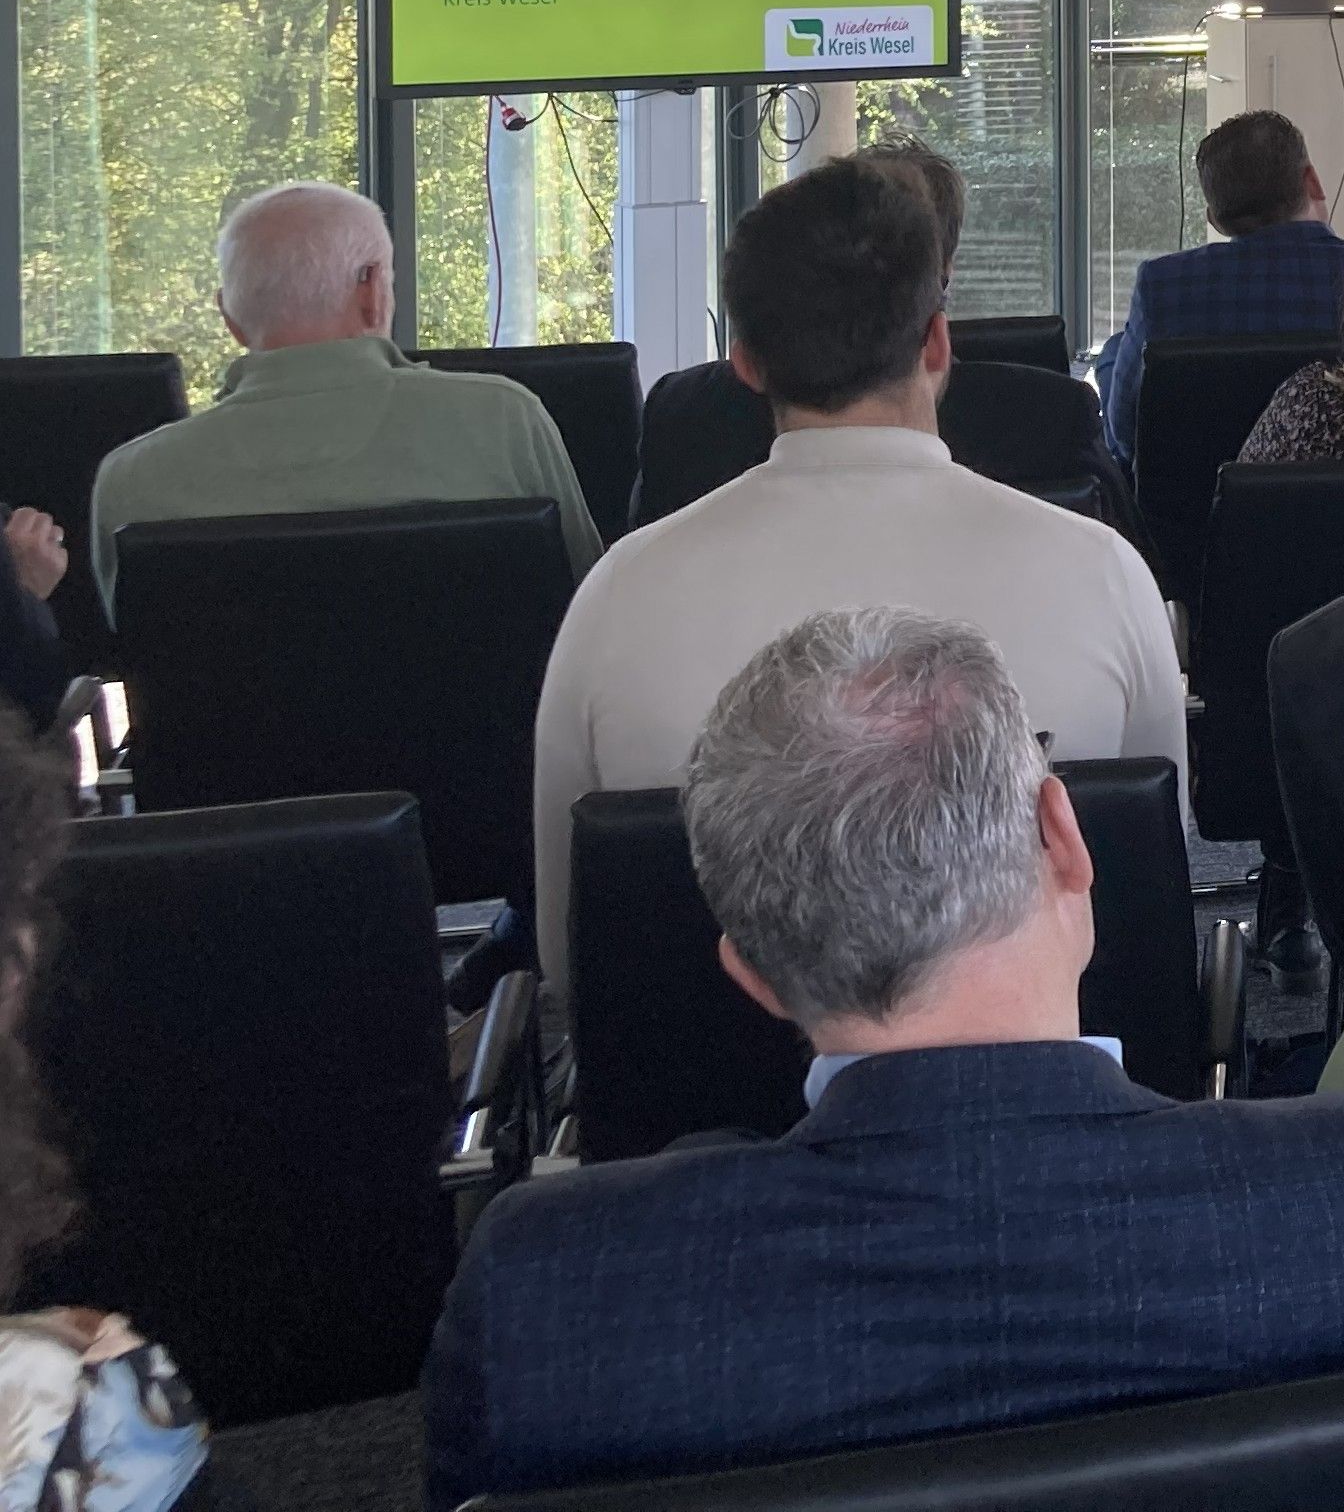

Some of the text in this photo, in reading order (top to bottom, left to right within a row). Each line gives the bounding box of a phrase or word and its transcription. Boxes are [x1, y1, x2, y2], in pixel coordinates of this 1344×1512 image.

[834, 16, 911, 36] Niederrhein
[827, 36, 915, 56] Kreis Wesel
